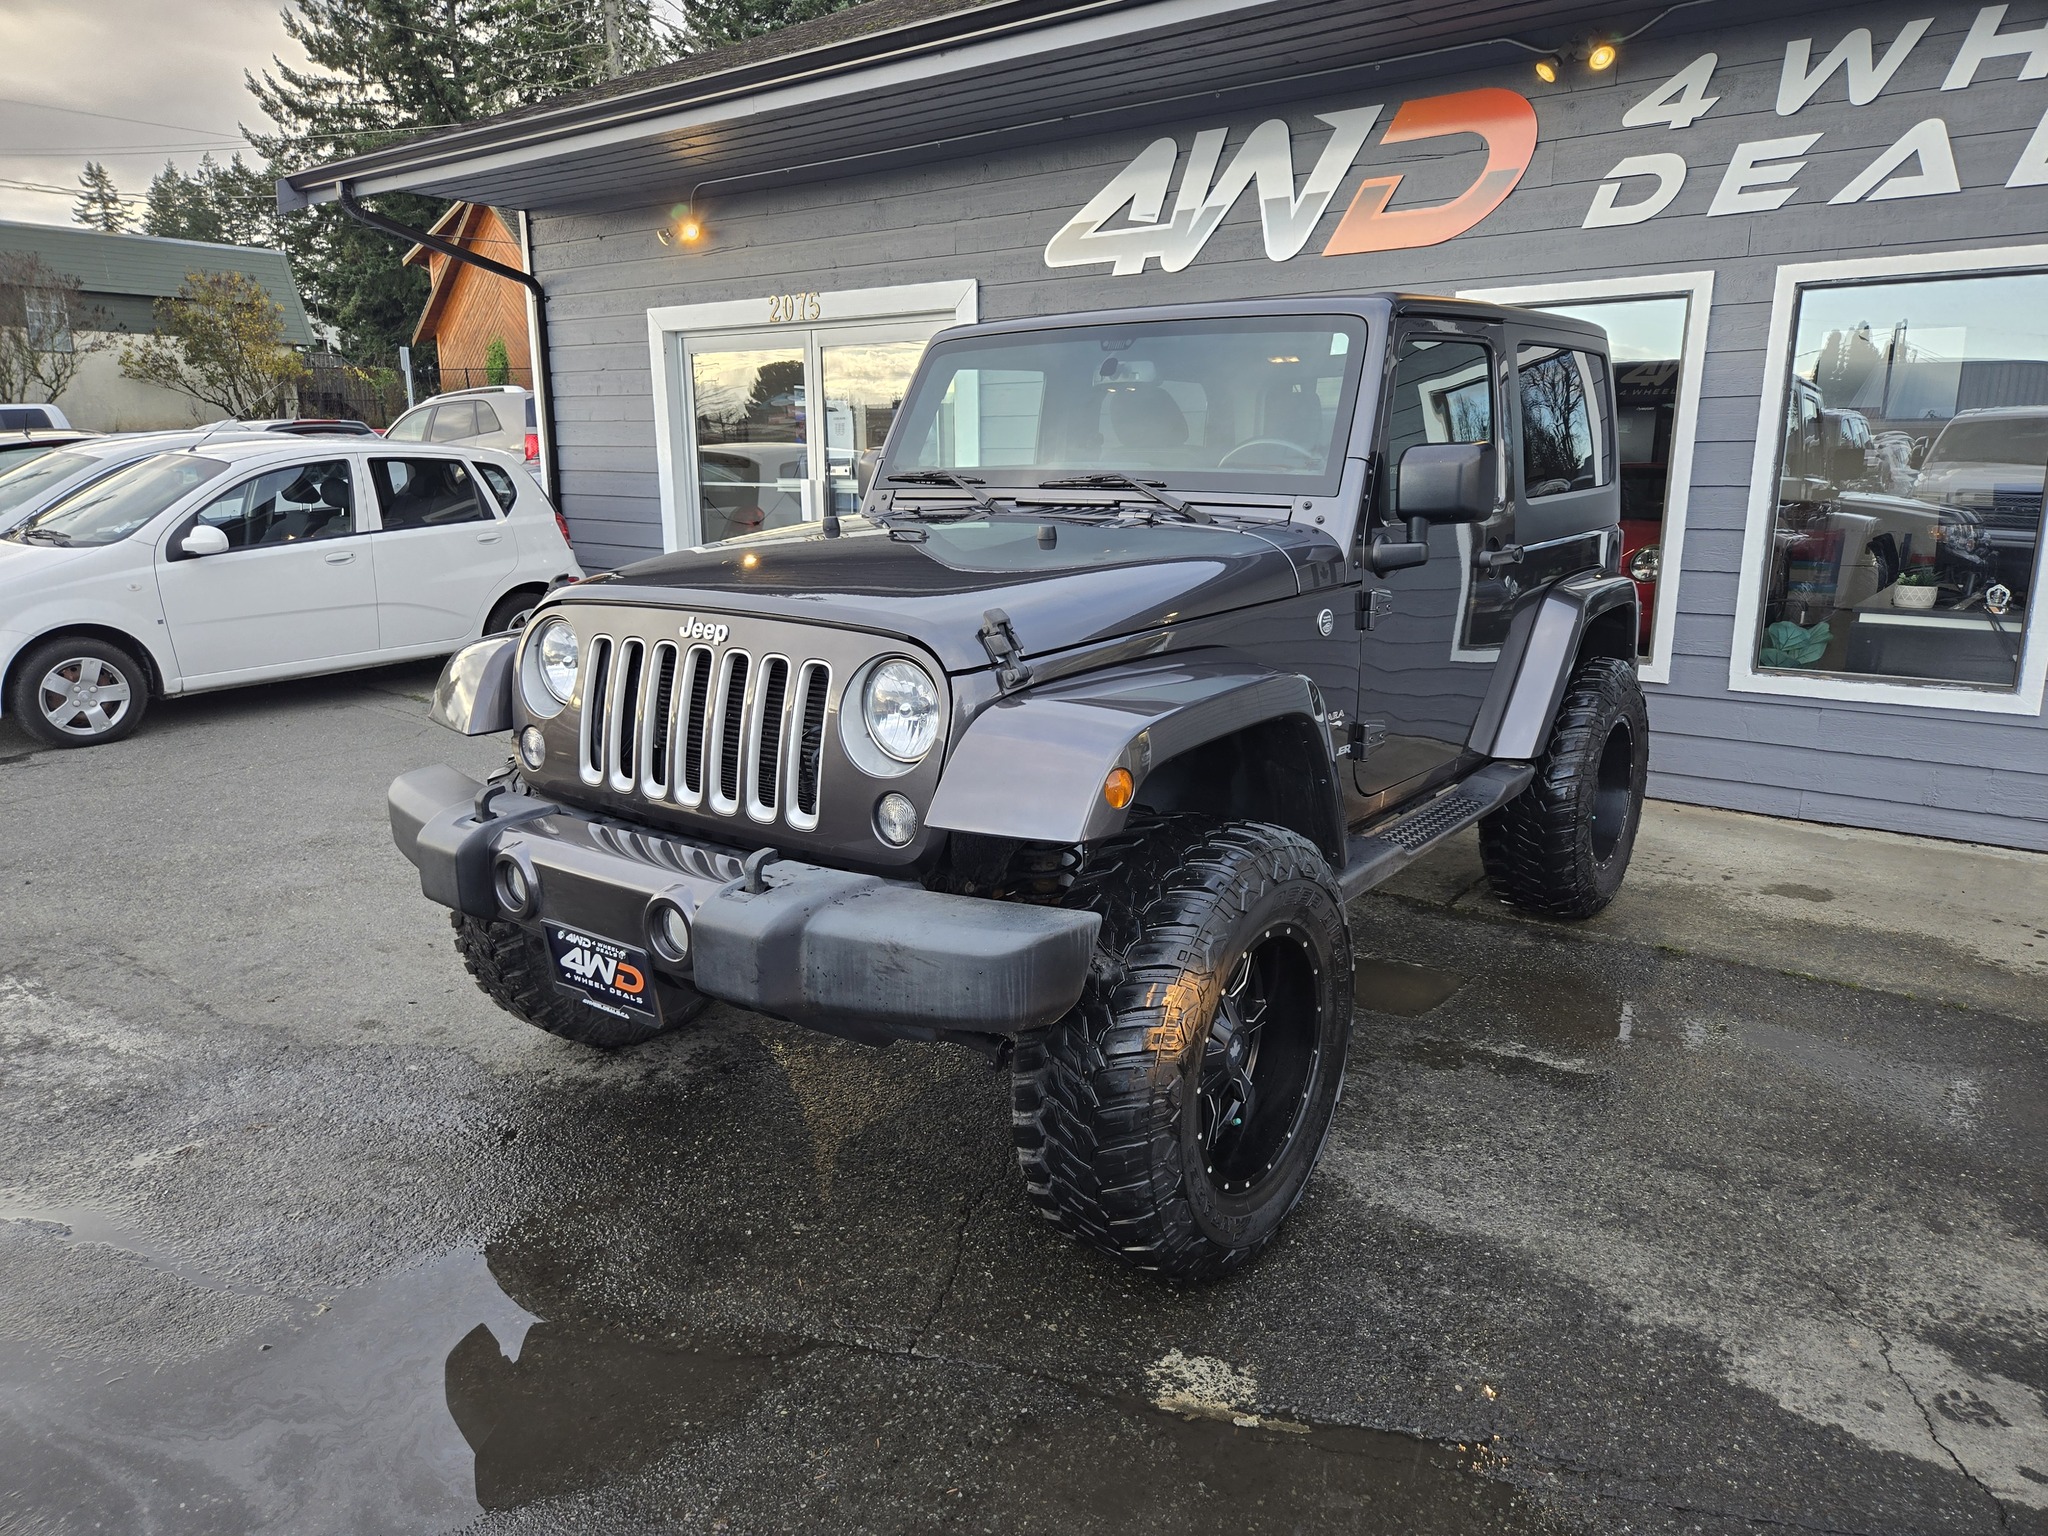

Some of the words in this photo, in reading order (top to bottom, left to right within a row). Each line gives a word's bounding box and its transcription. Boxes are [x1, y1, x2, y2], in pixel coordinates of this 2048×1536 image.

[1622, 52, 1720, 130] 4
[1045, 87, 1540, 275] 4WD
[769, 292, 821, 322] 2075
[679, 616, 730, 646] Jeep
[565, 933, 591, 948] 4WD
[595, 946, 618, 958] DEALS
[560, 947, 645, 994] 4WD
[574, 974, 606, 991] WHEEL
[610, 987, 643, 1005] DEALS
